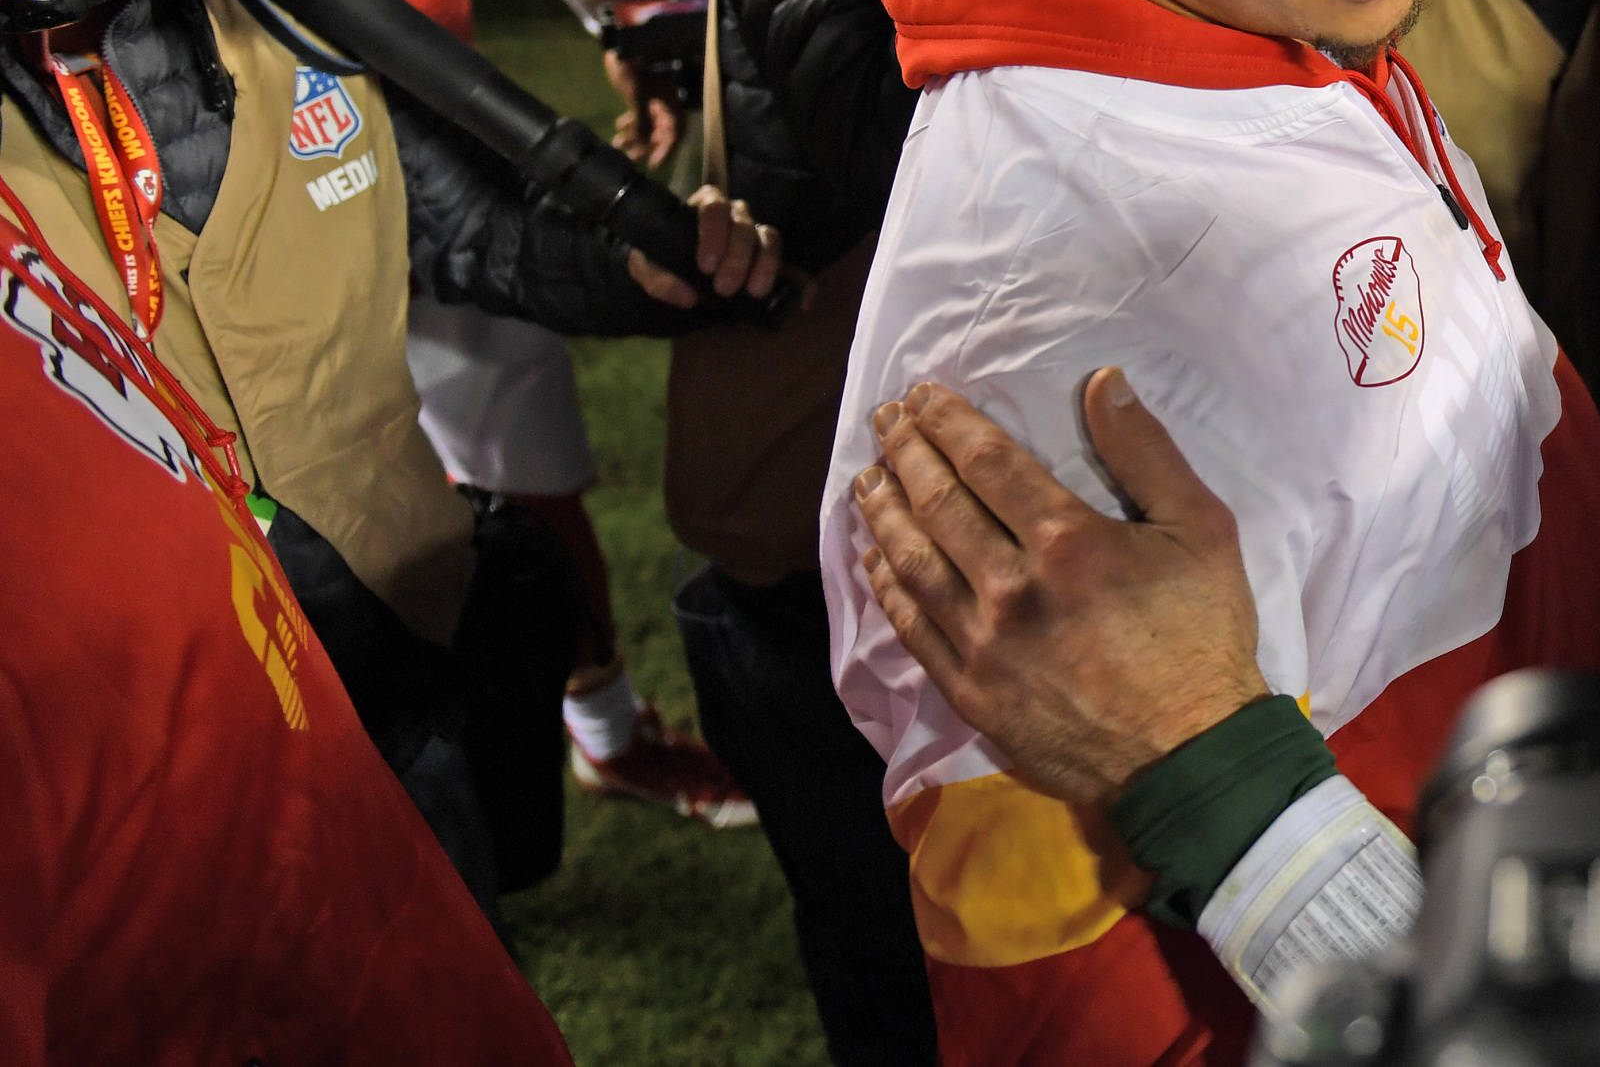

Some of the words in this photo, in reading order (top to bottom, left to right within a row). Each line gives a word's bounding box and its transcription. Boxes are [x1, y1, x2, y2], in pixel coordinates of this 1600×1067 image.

[67, 87, 119, 185] KINGDOM
[292, 96, 352, 149] NFL
[103, 188, 135, 252] CHIEFS
[124, 253, 137, 267] IS
[127, 268, 139, 296] THIS
[1342, 242, 1398, 361] Mahomes
[1382, 299, 1419, 357] 15
